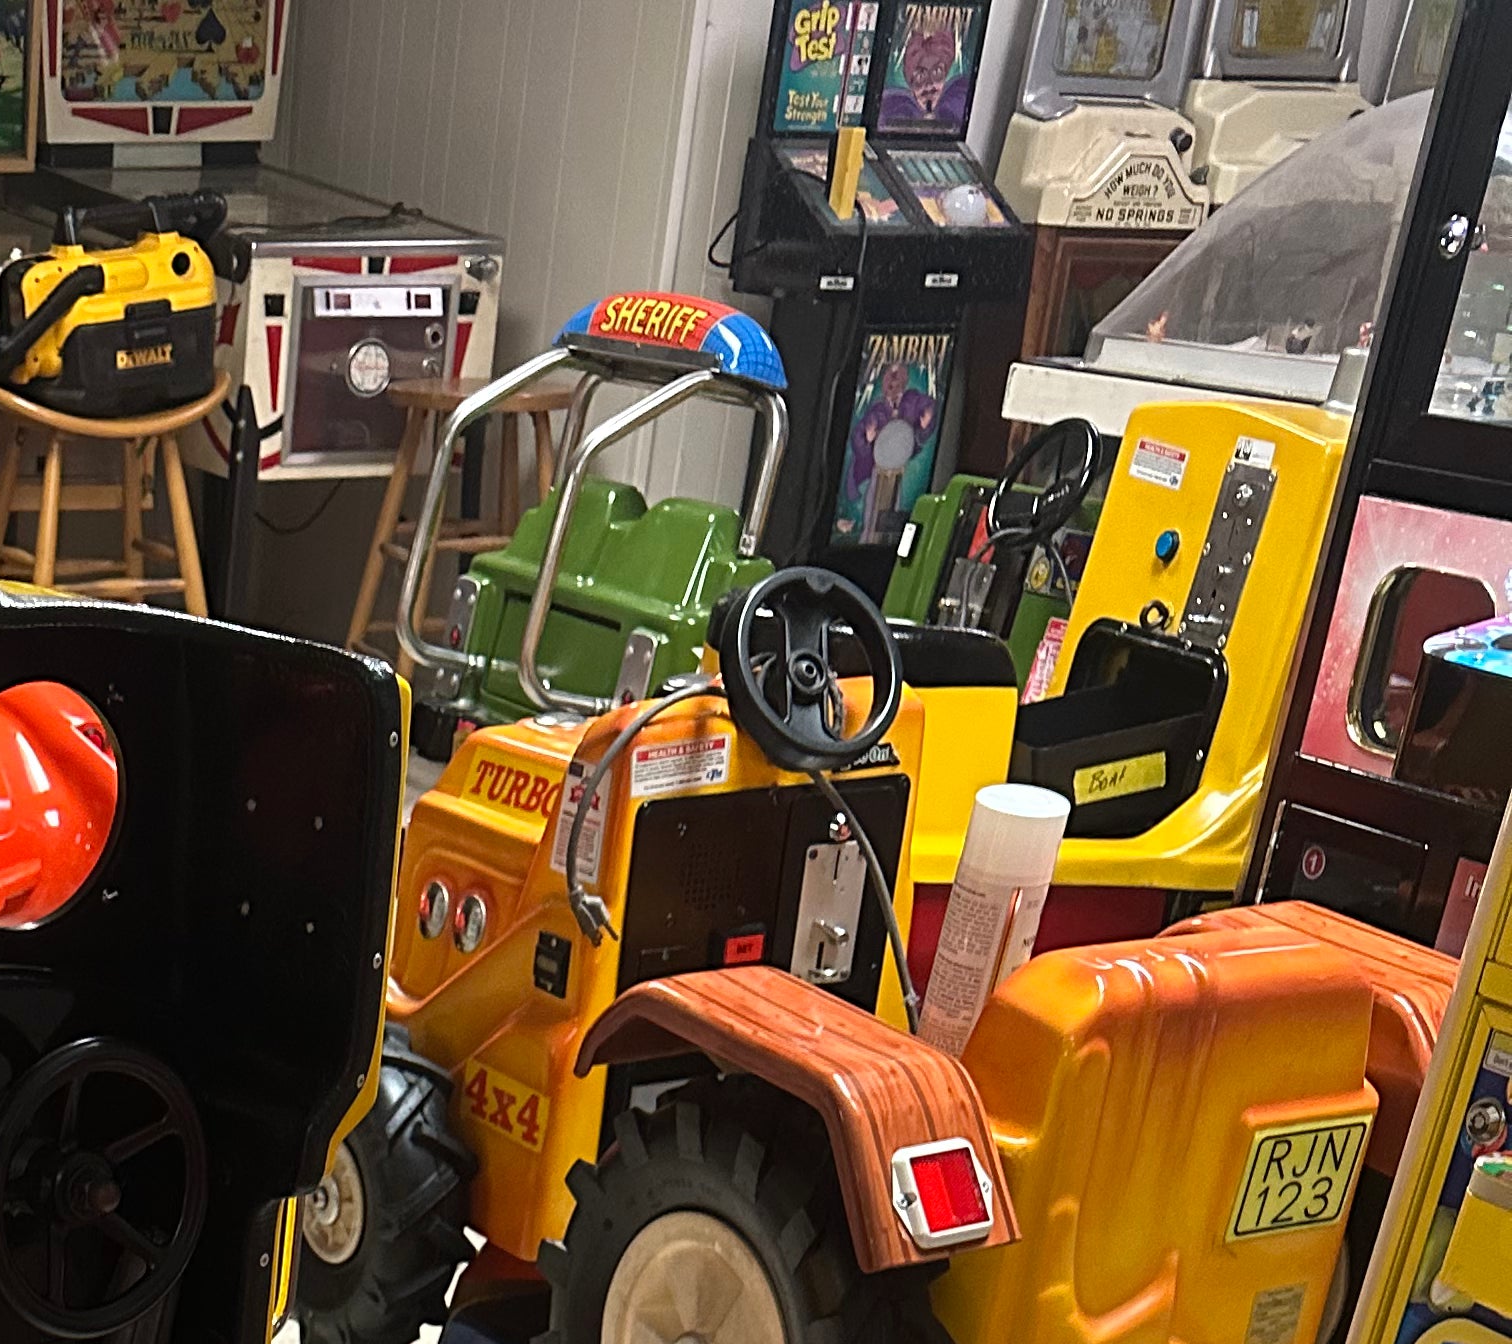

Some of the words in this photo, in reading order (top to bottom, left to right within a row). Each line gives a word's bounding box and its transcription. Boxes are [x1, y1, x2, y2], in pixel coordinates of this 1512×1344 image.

[794, 0, 840, 36] Grip
[795, 32, 838, 63] Test
[1104, 172, 1124, 200] HOW
[1125, 161, 1152, 180] MUCH
[1151, 162, 1165, 180] DO
[1095, 207, 1114, 221] NO
[1117, 208, 1175, 223] SPRINGS
[600, 296, 708, 344] SHERIFF
[1262, 1129, 1352, 1183] RJN
[1256, 1176, 1334, 1228] 123
